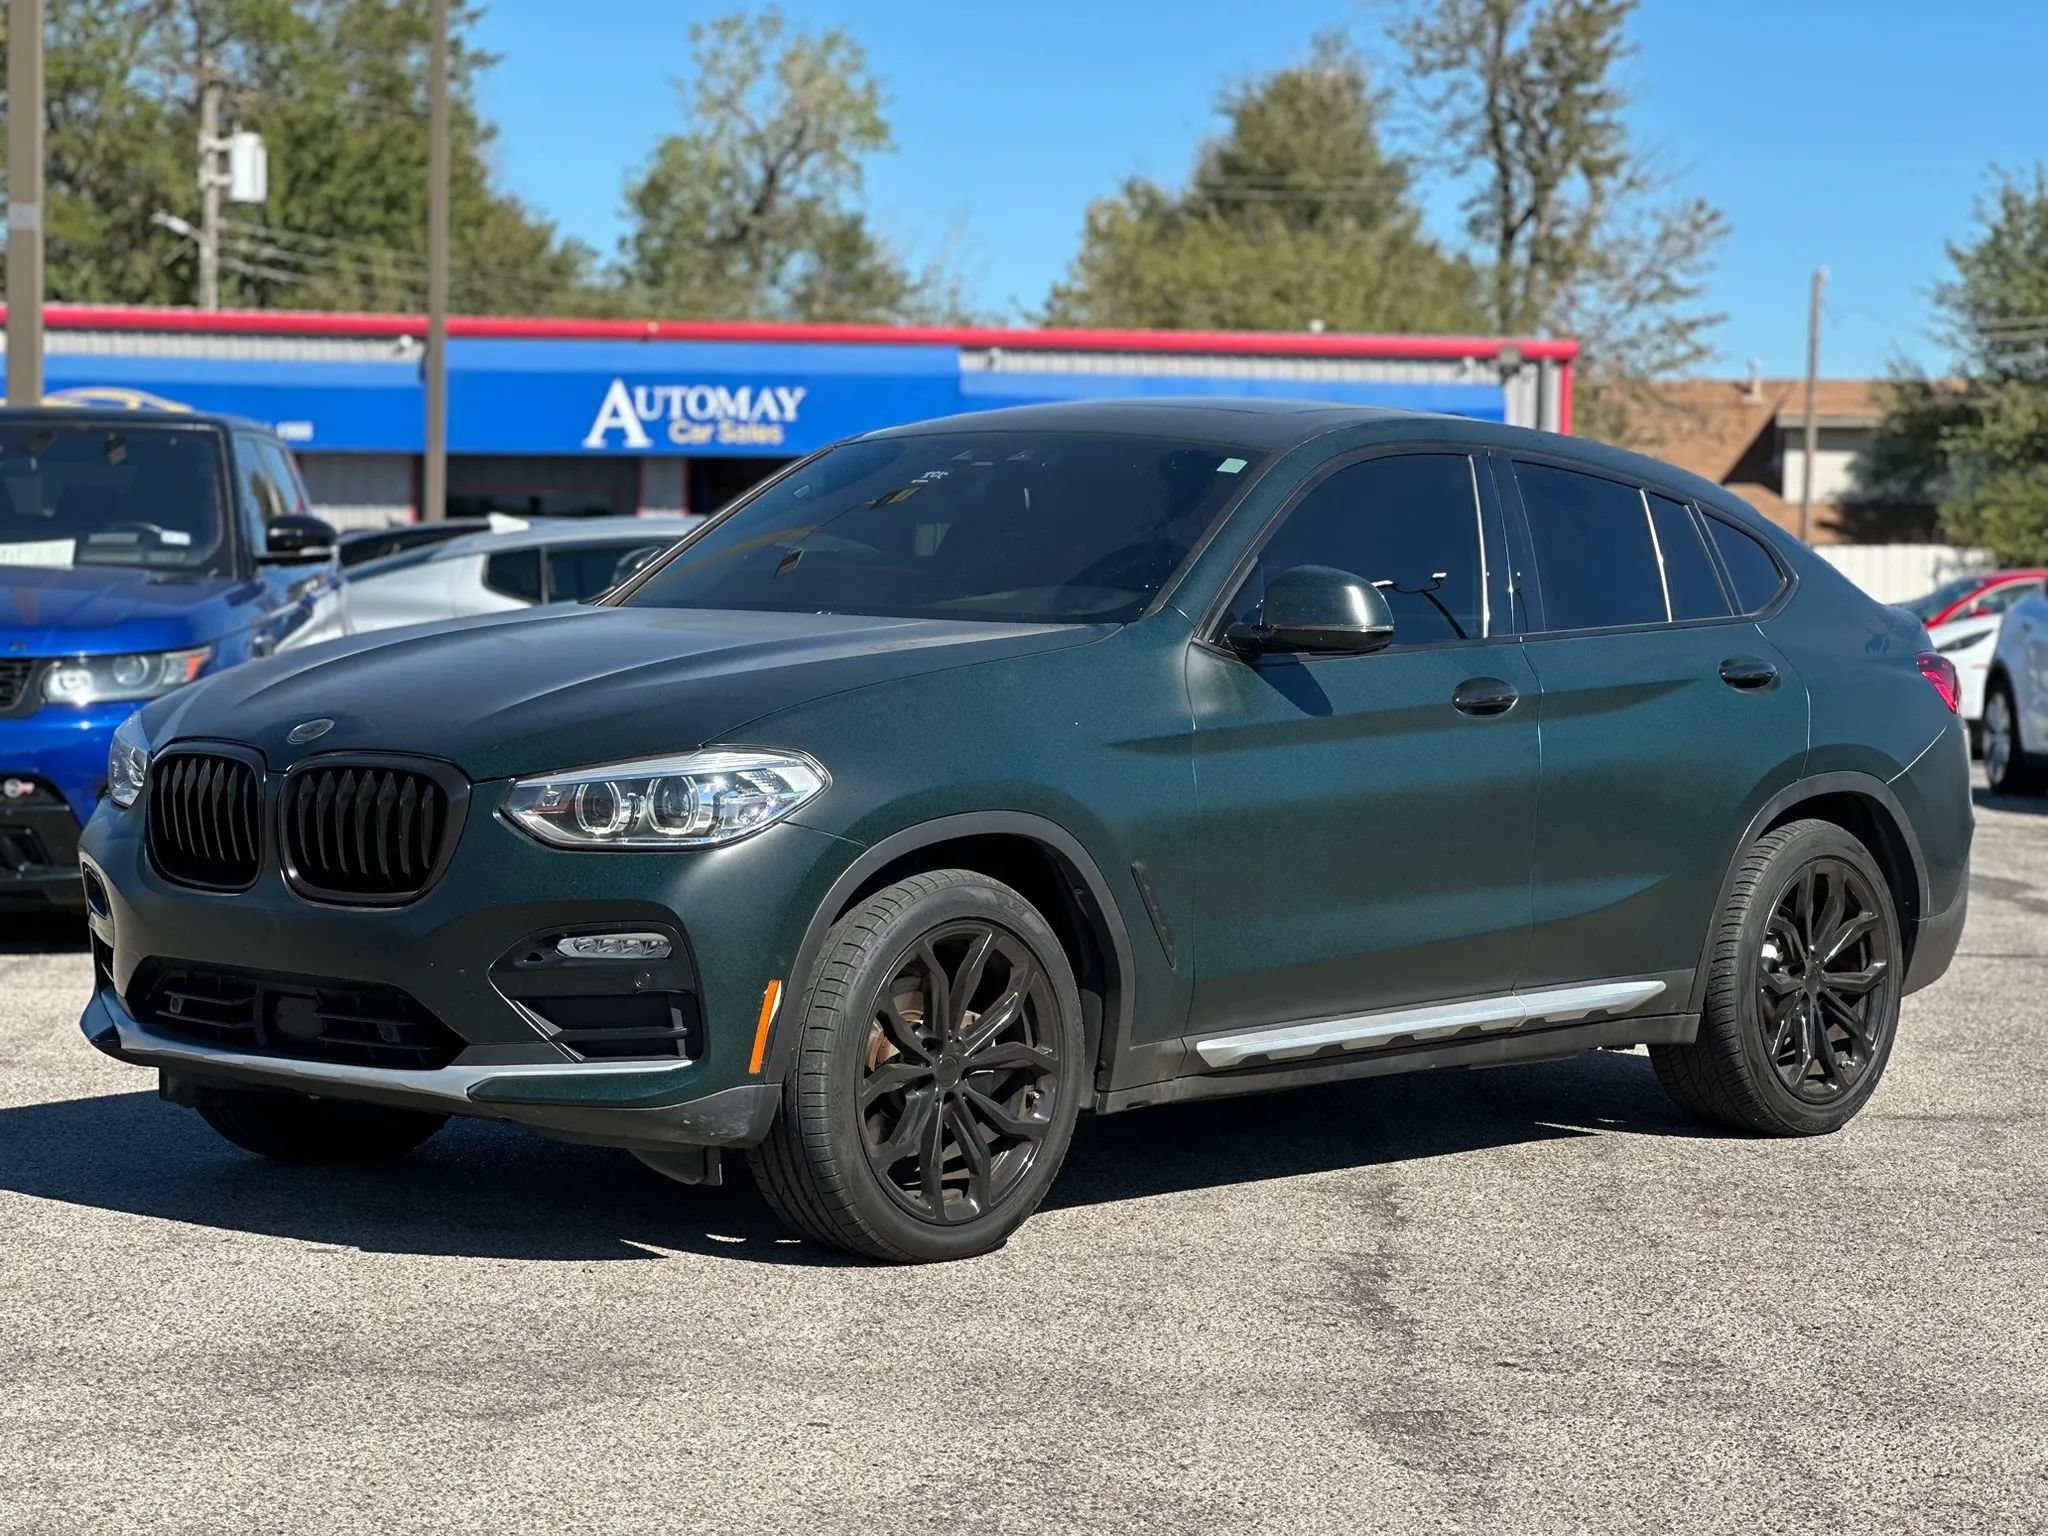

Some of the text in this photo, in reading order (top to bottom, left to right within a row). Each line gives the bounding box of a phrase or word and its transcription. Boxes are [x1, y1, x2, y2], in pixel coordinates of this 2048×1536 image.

[583, 377, 807, 449] AUTOMAY
[668, 419, 784, 445] Car Sales
